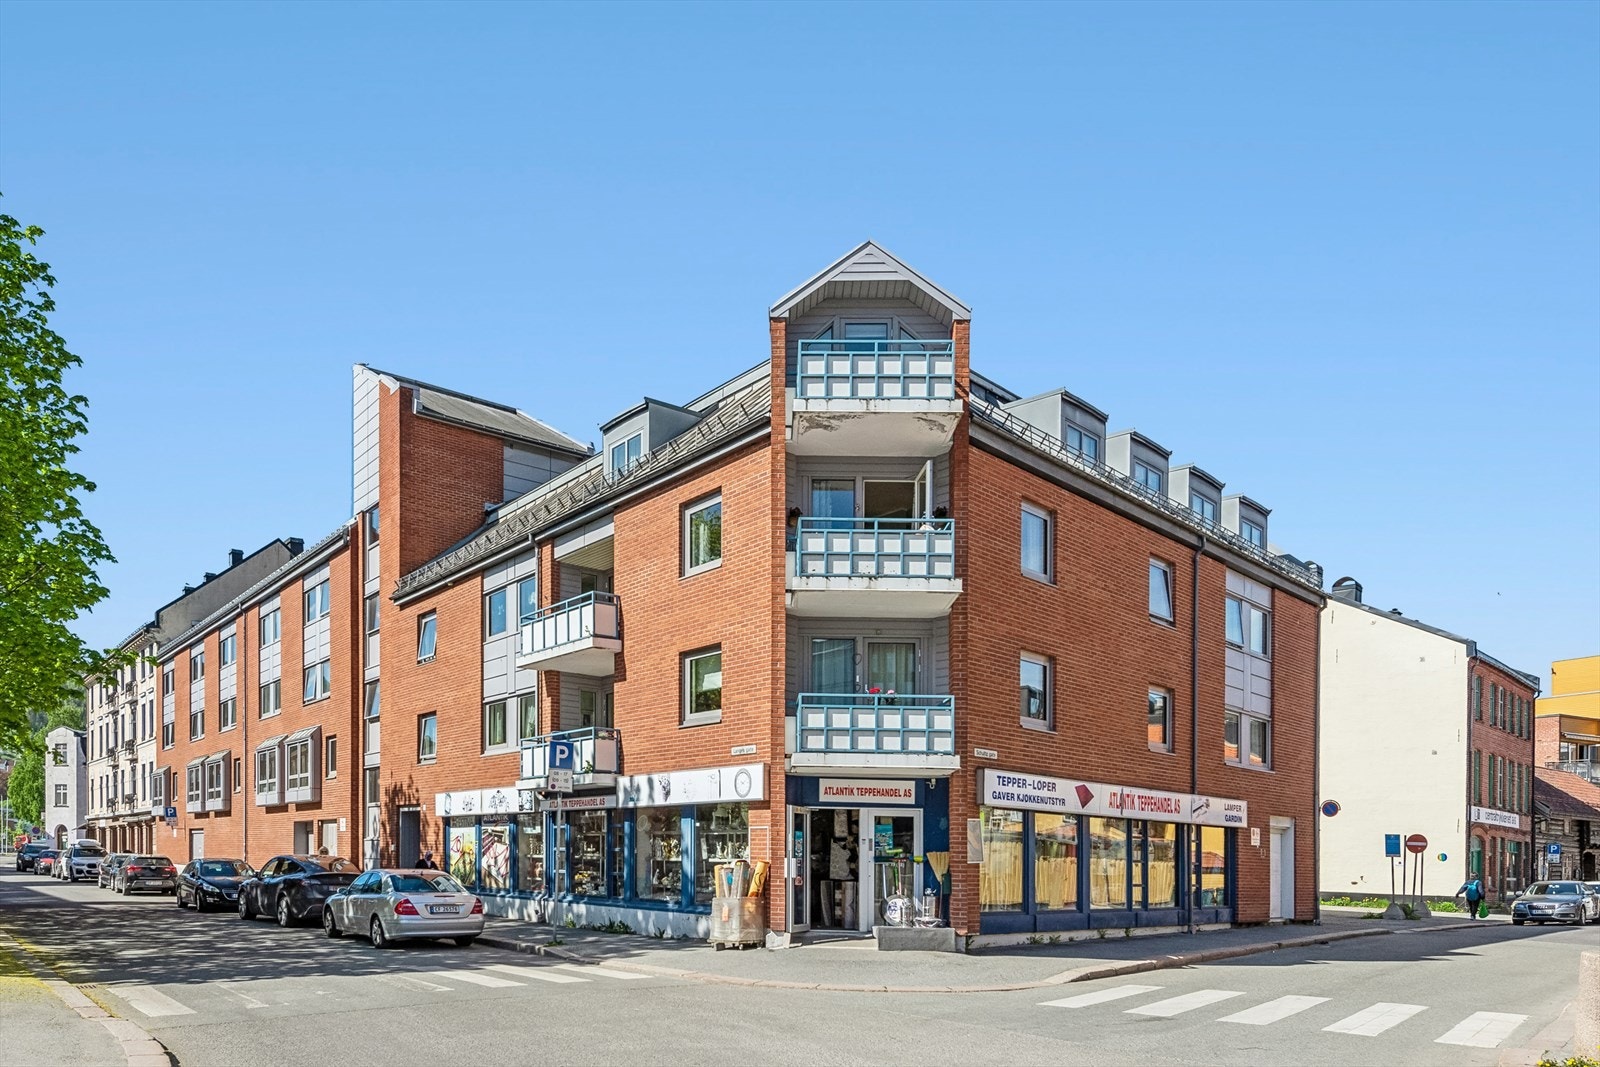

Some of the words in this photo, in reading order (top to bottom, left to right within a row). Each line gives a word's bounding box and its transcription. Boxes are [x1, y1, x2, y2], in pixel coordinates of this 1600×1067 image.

[556, 745, 569, 766] P
[856, 787, 901, 798] TEPPEHANDEL
[903, 788, 912, 798] AS
[992, 790, 1015, 802] GAVER
[568, 798, 598, 808] TEPPEHANDEL
[599, 797, 606, 806] AS
[1137, 794, 1173, 814] TEPPEHANDEL
[1173, 798, 1181, 814] AS
[1224, 803, 1242, 813] LAMPER
[167, 807, 174, 818] P
[1550, 845, 1558, 853] P
